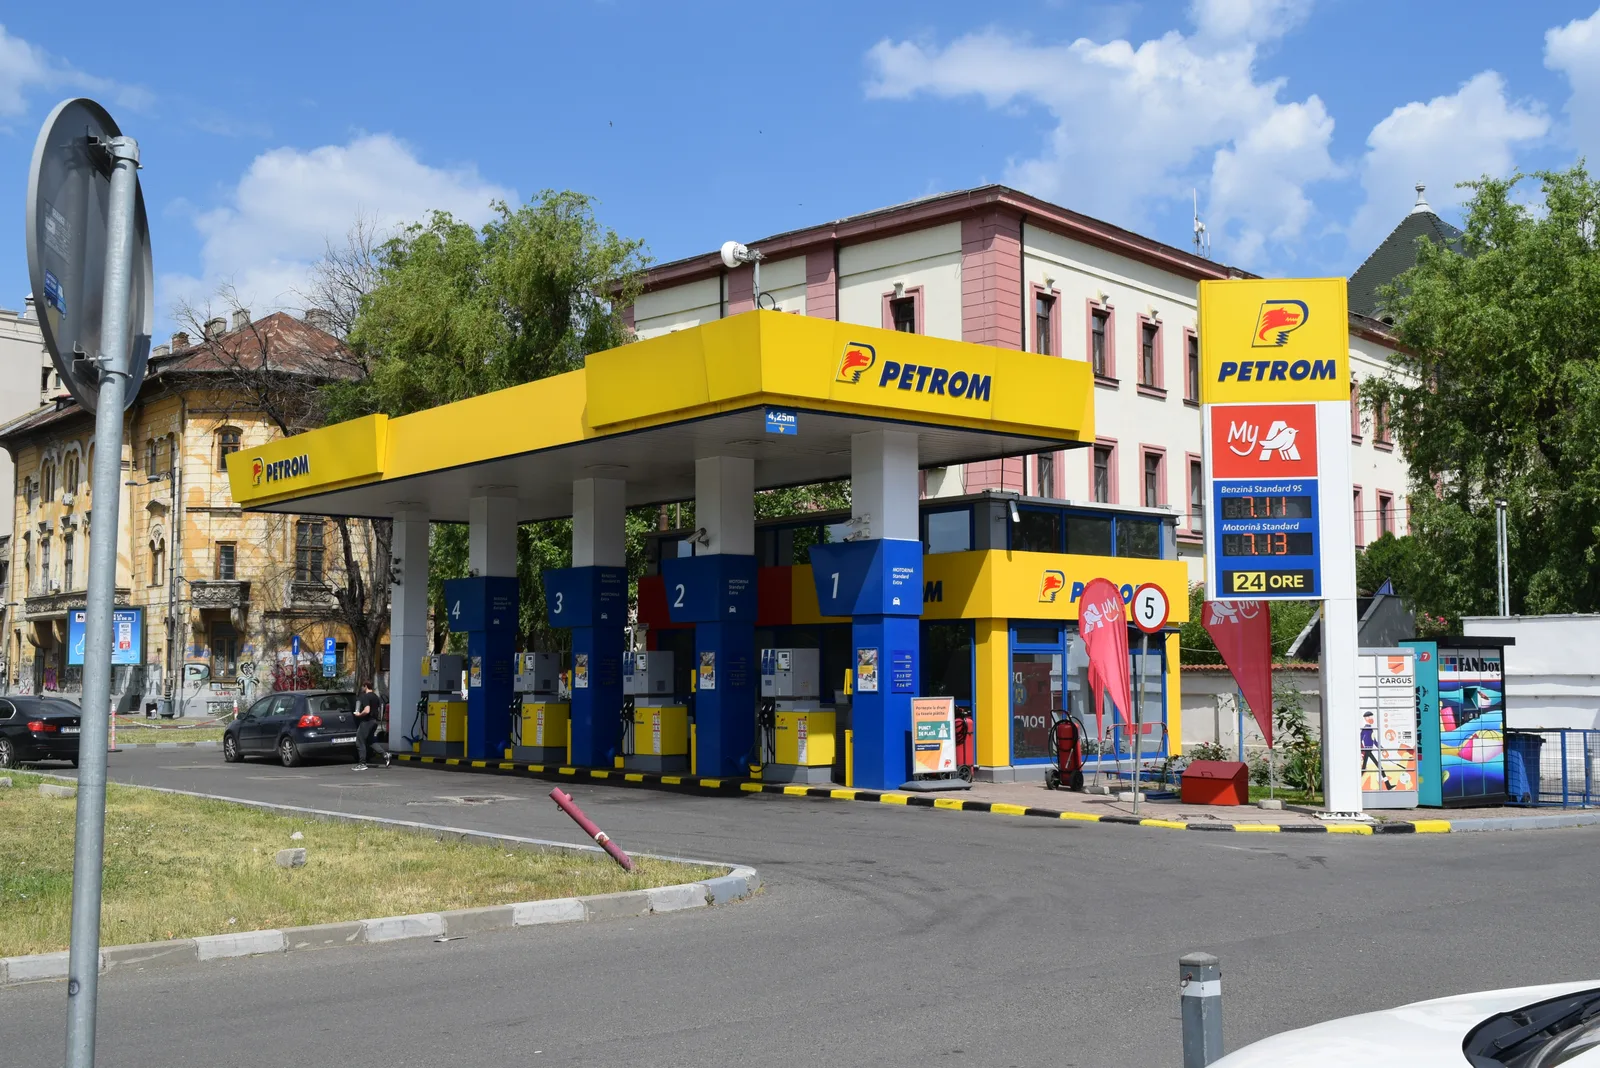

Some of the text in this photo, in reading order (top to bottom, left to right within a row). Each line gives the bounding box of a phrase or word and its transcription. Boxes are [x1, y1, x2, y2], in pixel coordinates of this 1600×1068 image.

[879, 360, 992, 401] PETROM
[1217, 359, 1337, 382] PETROM
[768, 411, 795, 423] 4,25m
[1227, 420, 1259, 457] My
[266, 454, 310, 482] PETROM
[1254, 484, 1291, 493] Standard
[1292, 484, 1303, 492] 95
[1242, 496, 1287, 517] 7.11
[1222, 521, 1300, 531] Motorină Standard
[1242, 532, 1288, 555] 7.13
[831, 572, 840, 599] 1
[1236, 573, 1304, 591] 24 ORE
[553, 591, 564, 614] 3
[673, 583, 685, 608] 2
[451, 600, 461, 620] 4
[1144, 596, 1155, 620] 5
[326, 640, 333, 650] P
[1459, 657, 1501, 672] FANbox
